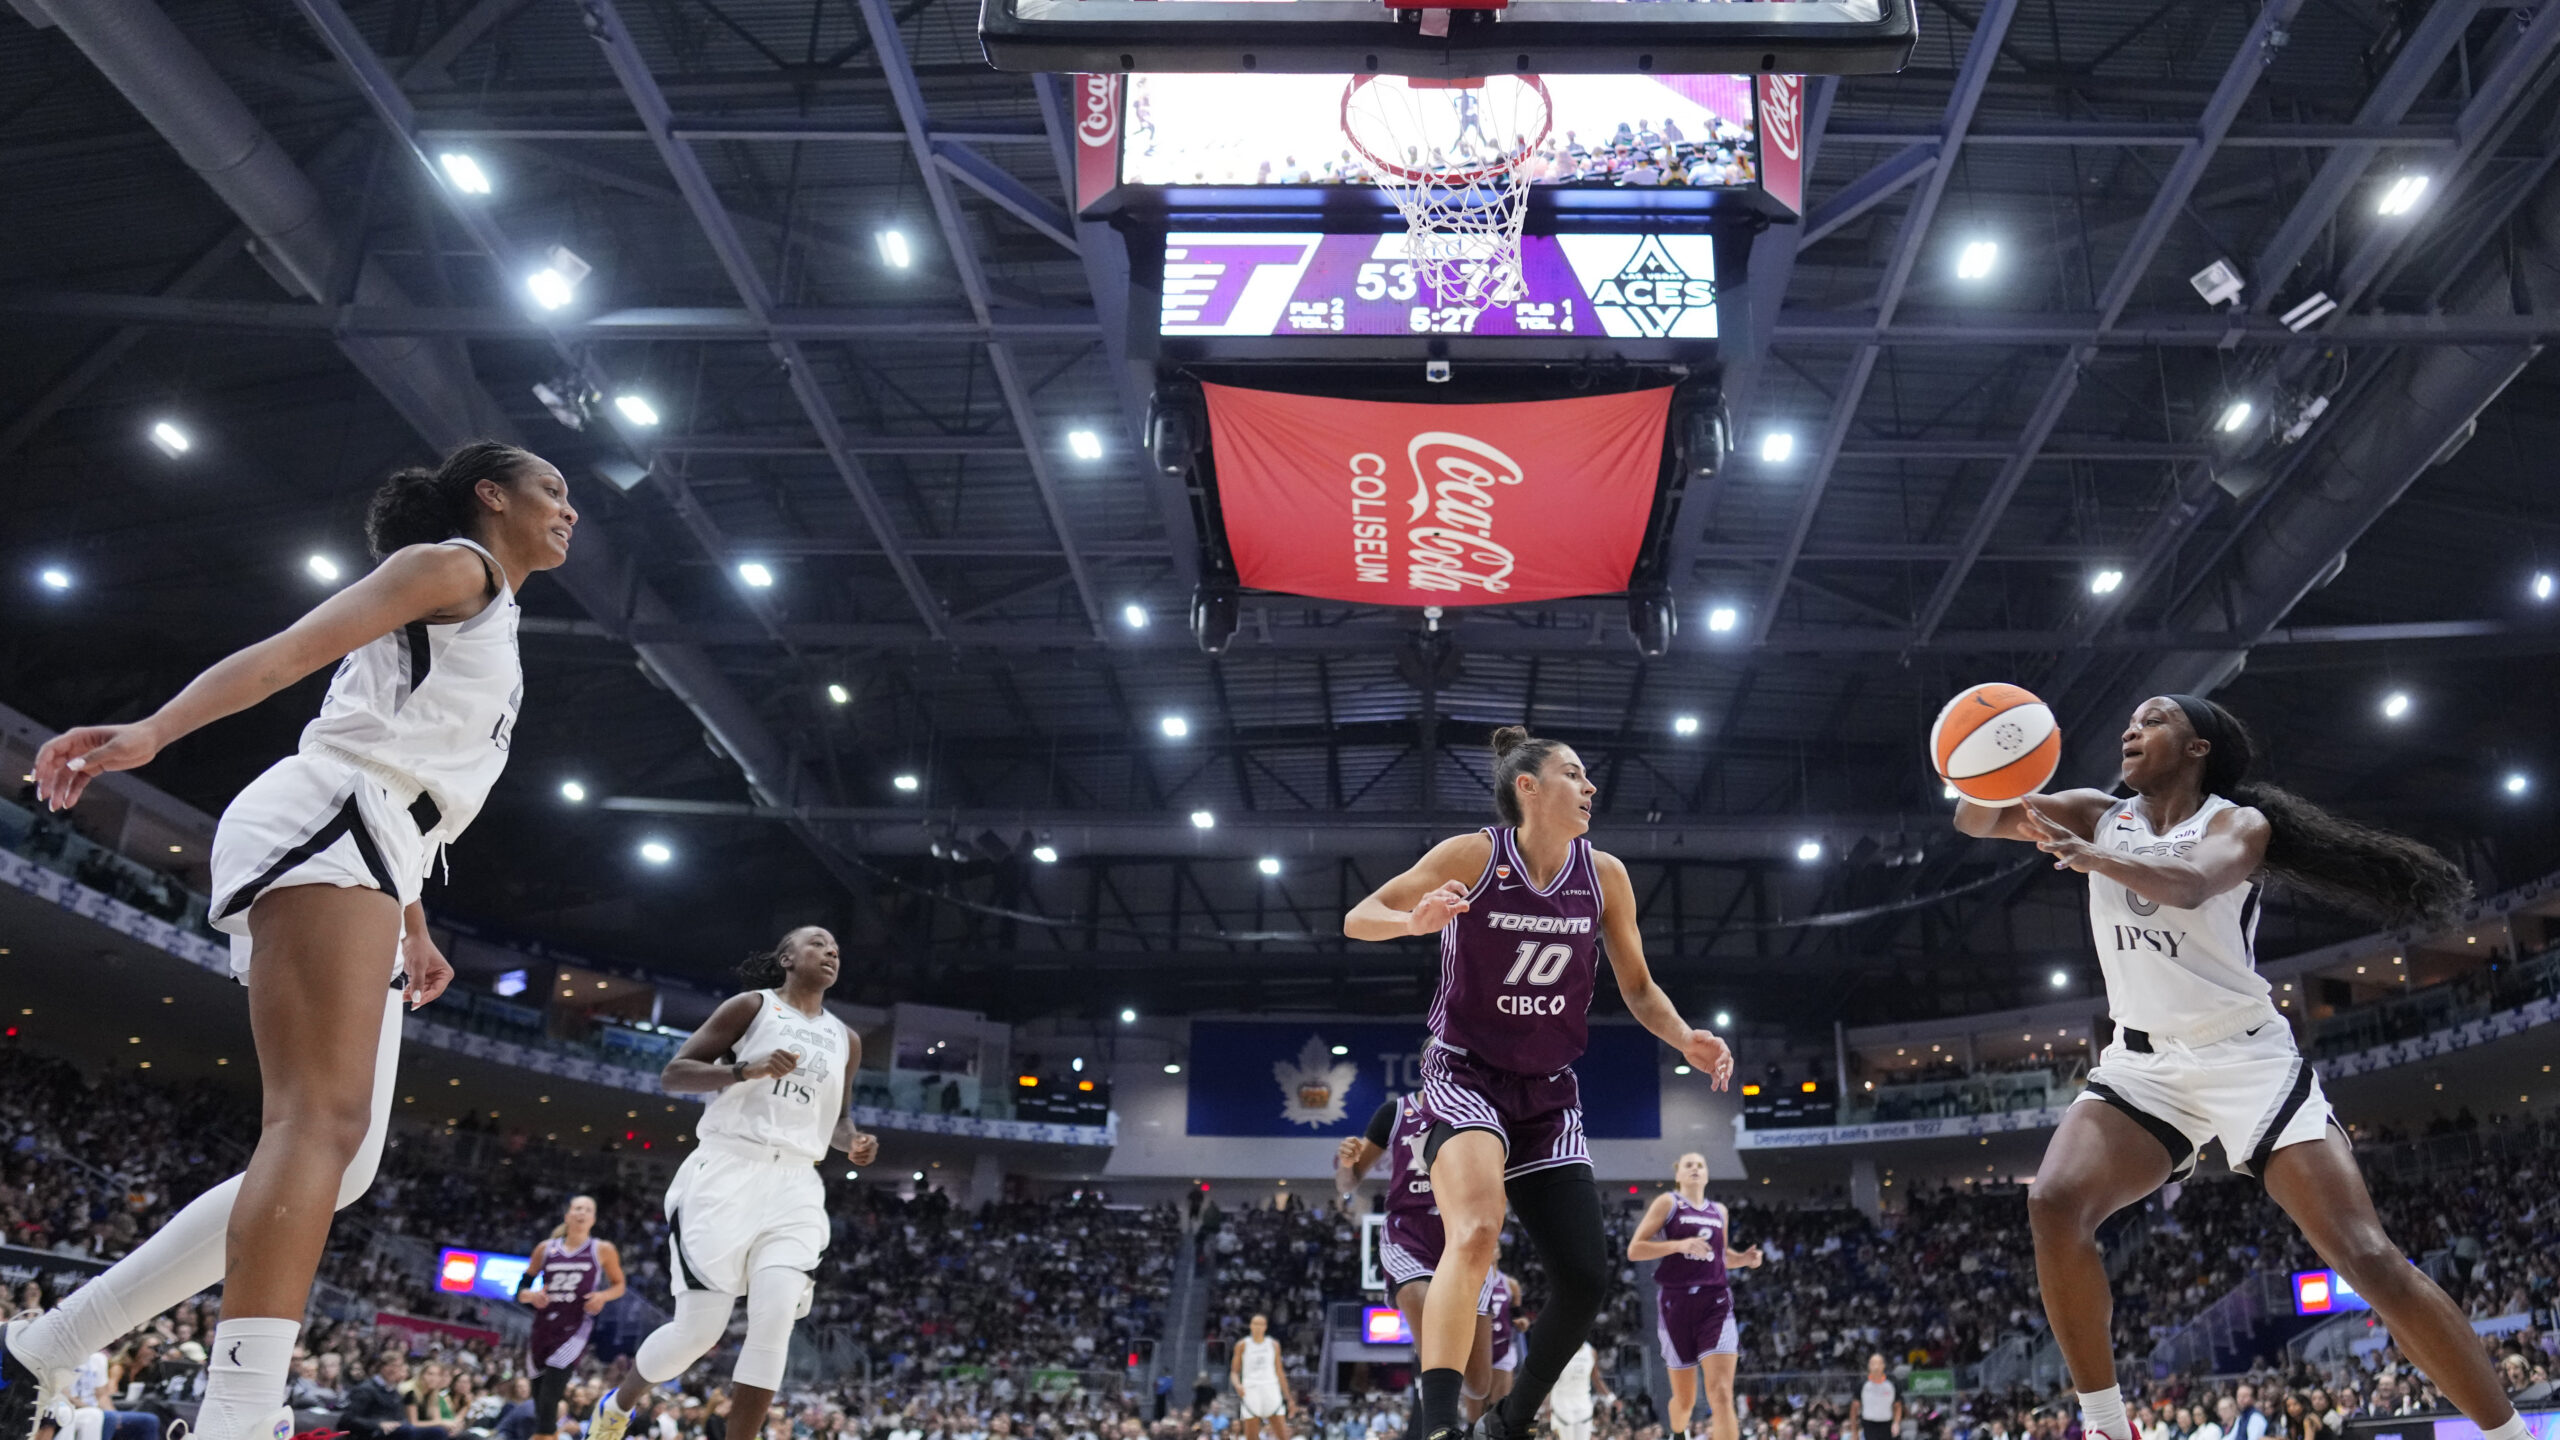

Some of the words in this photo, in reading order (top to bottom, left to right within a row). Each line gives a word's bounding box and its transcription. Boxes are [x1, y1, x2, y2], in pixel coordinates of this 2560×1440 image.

[1355, 263, 1418, 300] 53
[1459, 263, 1521, 300] 72
[1593, 280, 1712, 306] ACES
[1331, 297, 1344, 314] 2
[1562, 298, 1572, 315] 1
[1330, 314, 1344, 331] 3
[1410, 307, 1481, 333] 5:27
[1560, 315, 1574, 332] 4
[1349, 452, 1389, 583] COLISEUM
[1406, 431, 1524, 594] Coca-Cola
[2174, 828, 2199, 839] ally
[1487, 911, 1592, 935] TORONTO
[2114, 924, 2187, 958] IPSY
[1503, 940, 1573, 986] 10
[1497, 995, 1548, 1016] CIBC
[779, 1024, 837, 1054] ACES
[788, 1043, 830, 1084] 24
[1409, 1180, 1433, 1194] CIB
[548, 1272, 583, 1291] 22
